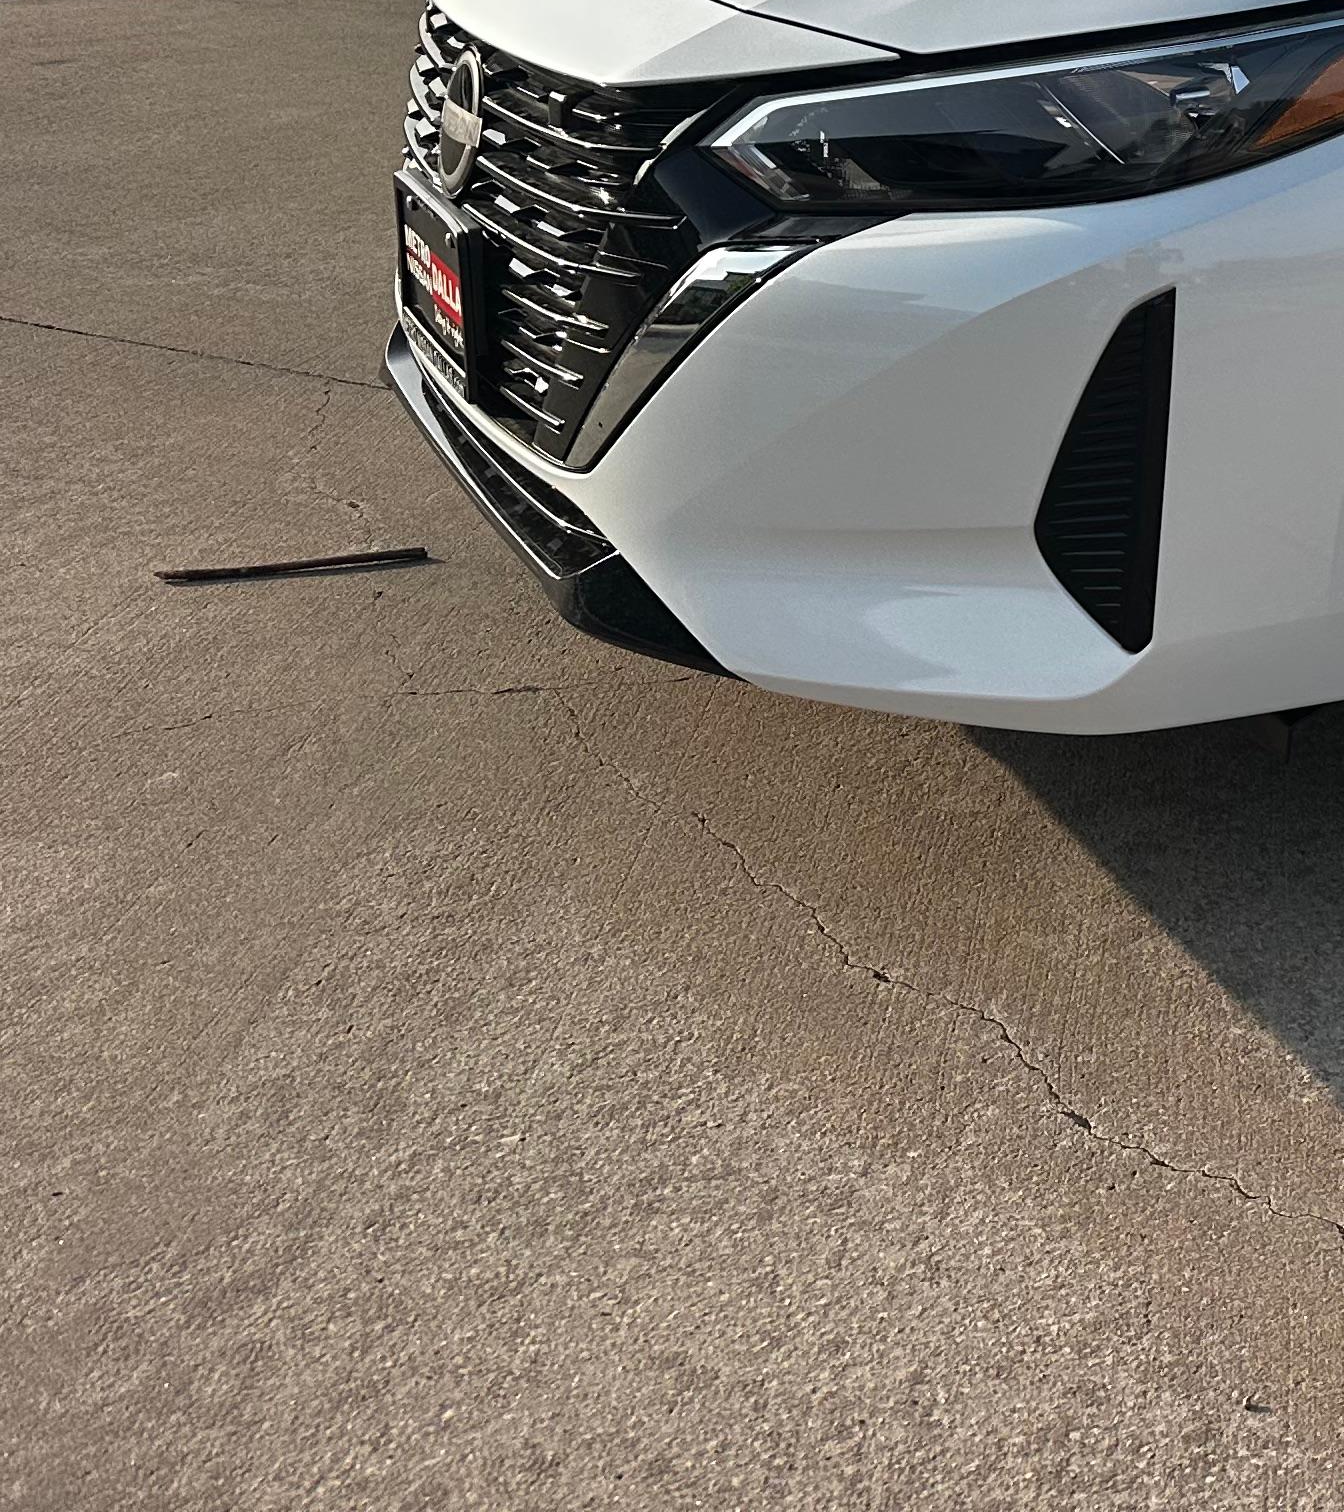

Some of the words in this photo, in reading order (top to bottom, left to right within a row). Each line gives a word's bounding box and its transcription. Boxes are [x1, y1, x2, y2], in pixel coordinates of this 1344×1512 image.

[404, 223, 431, 268] METRO
[406, 251, 433, 295] NISSAN
[431, 262, 462, 317] DALLA
